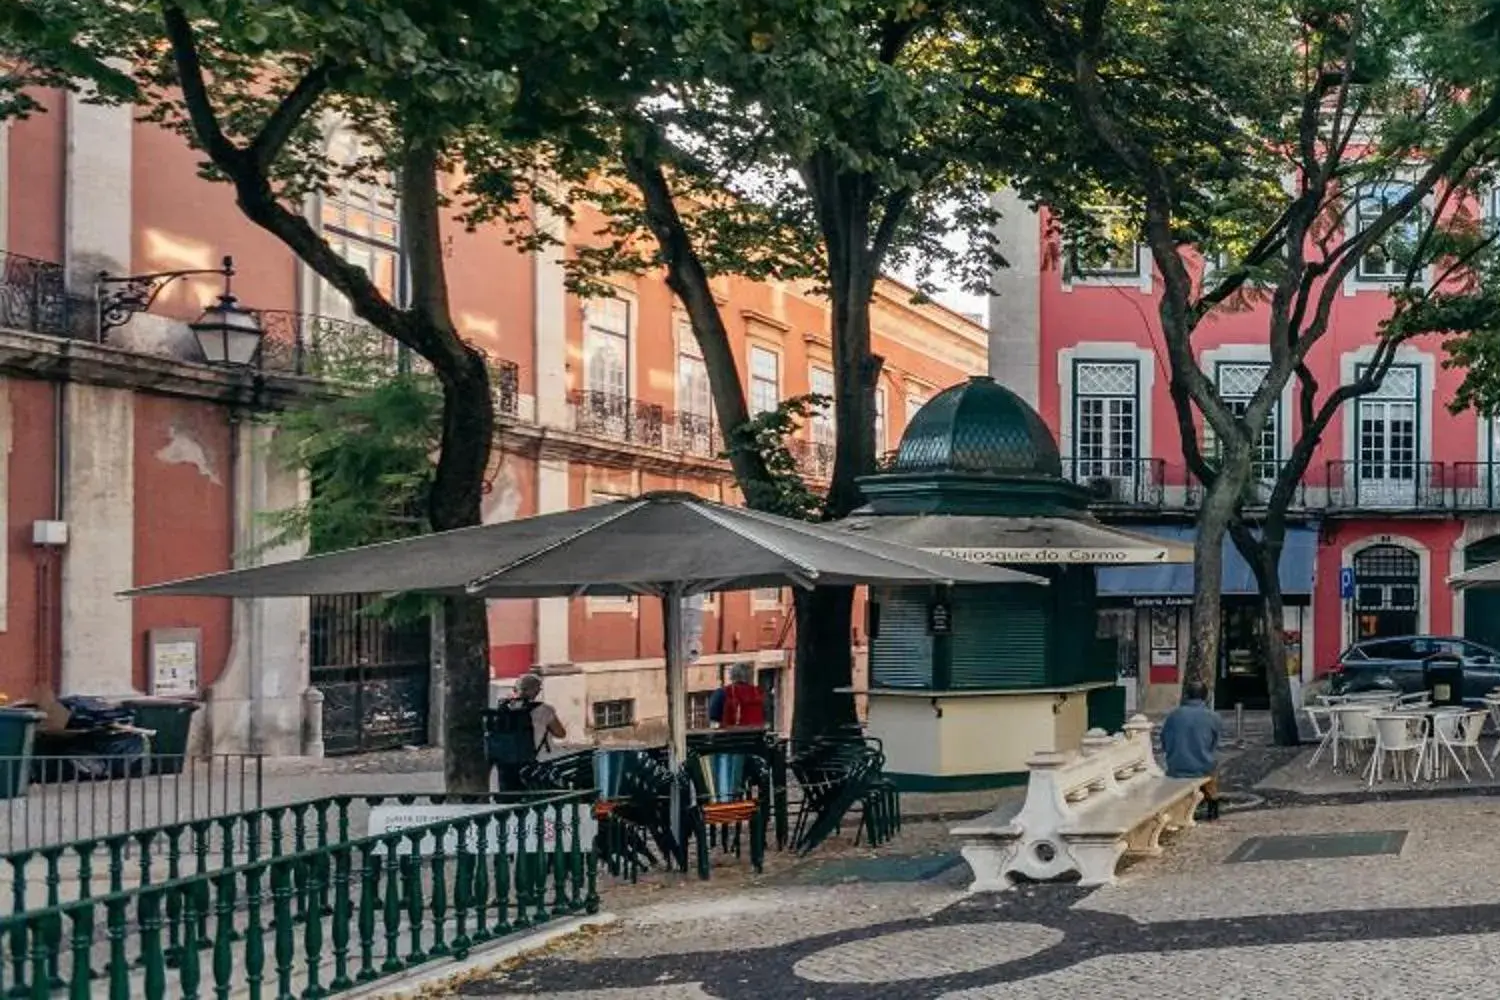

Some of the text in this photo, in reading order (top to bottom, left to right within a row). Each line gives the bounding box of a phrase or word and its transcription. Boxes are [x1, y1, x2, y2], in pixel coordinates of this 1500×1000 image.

[1035, 549, 1059, 561] do
[1068, 549, 1127, 561] Carmo
[1342, 573, 1351, 597] P
